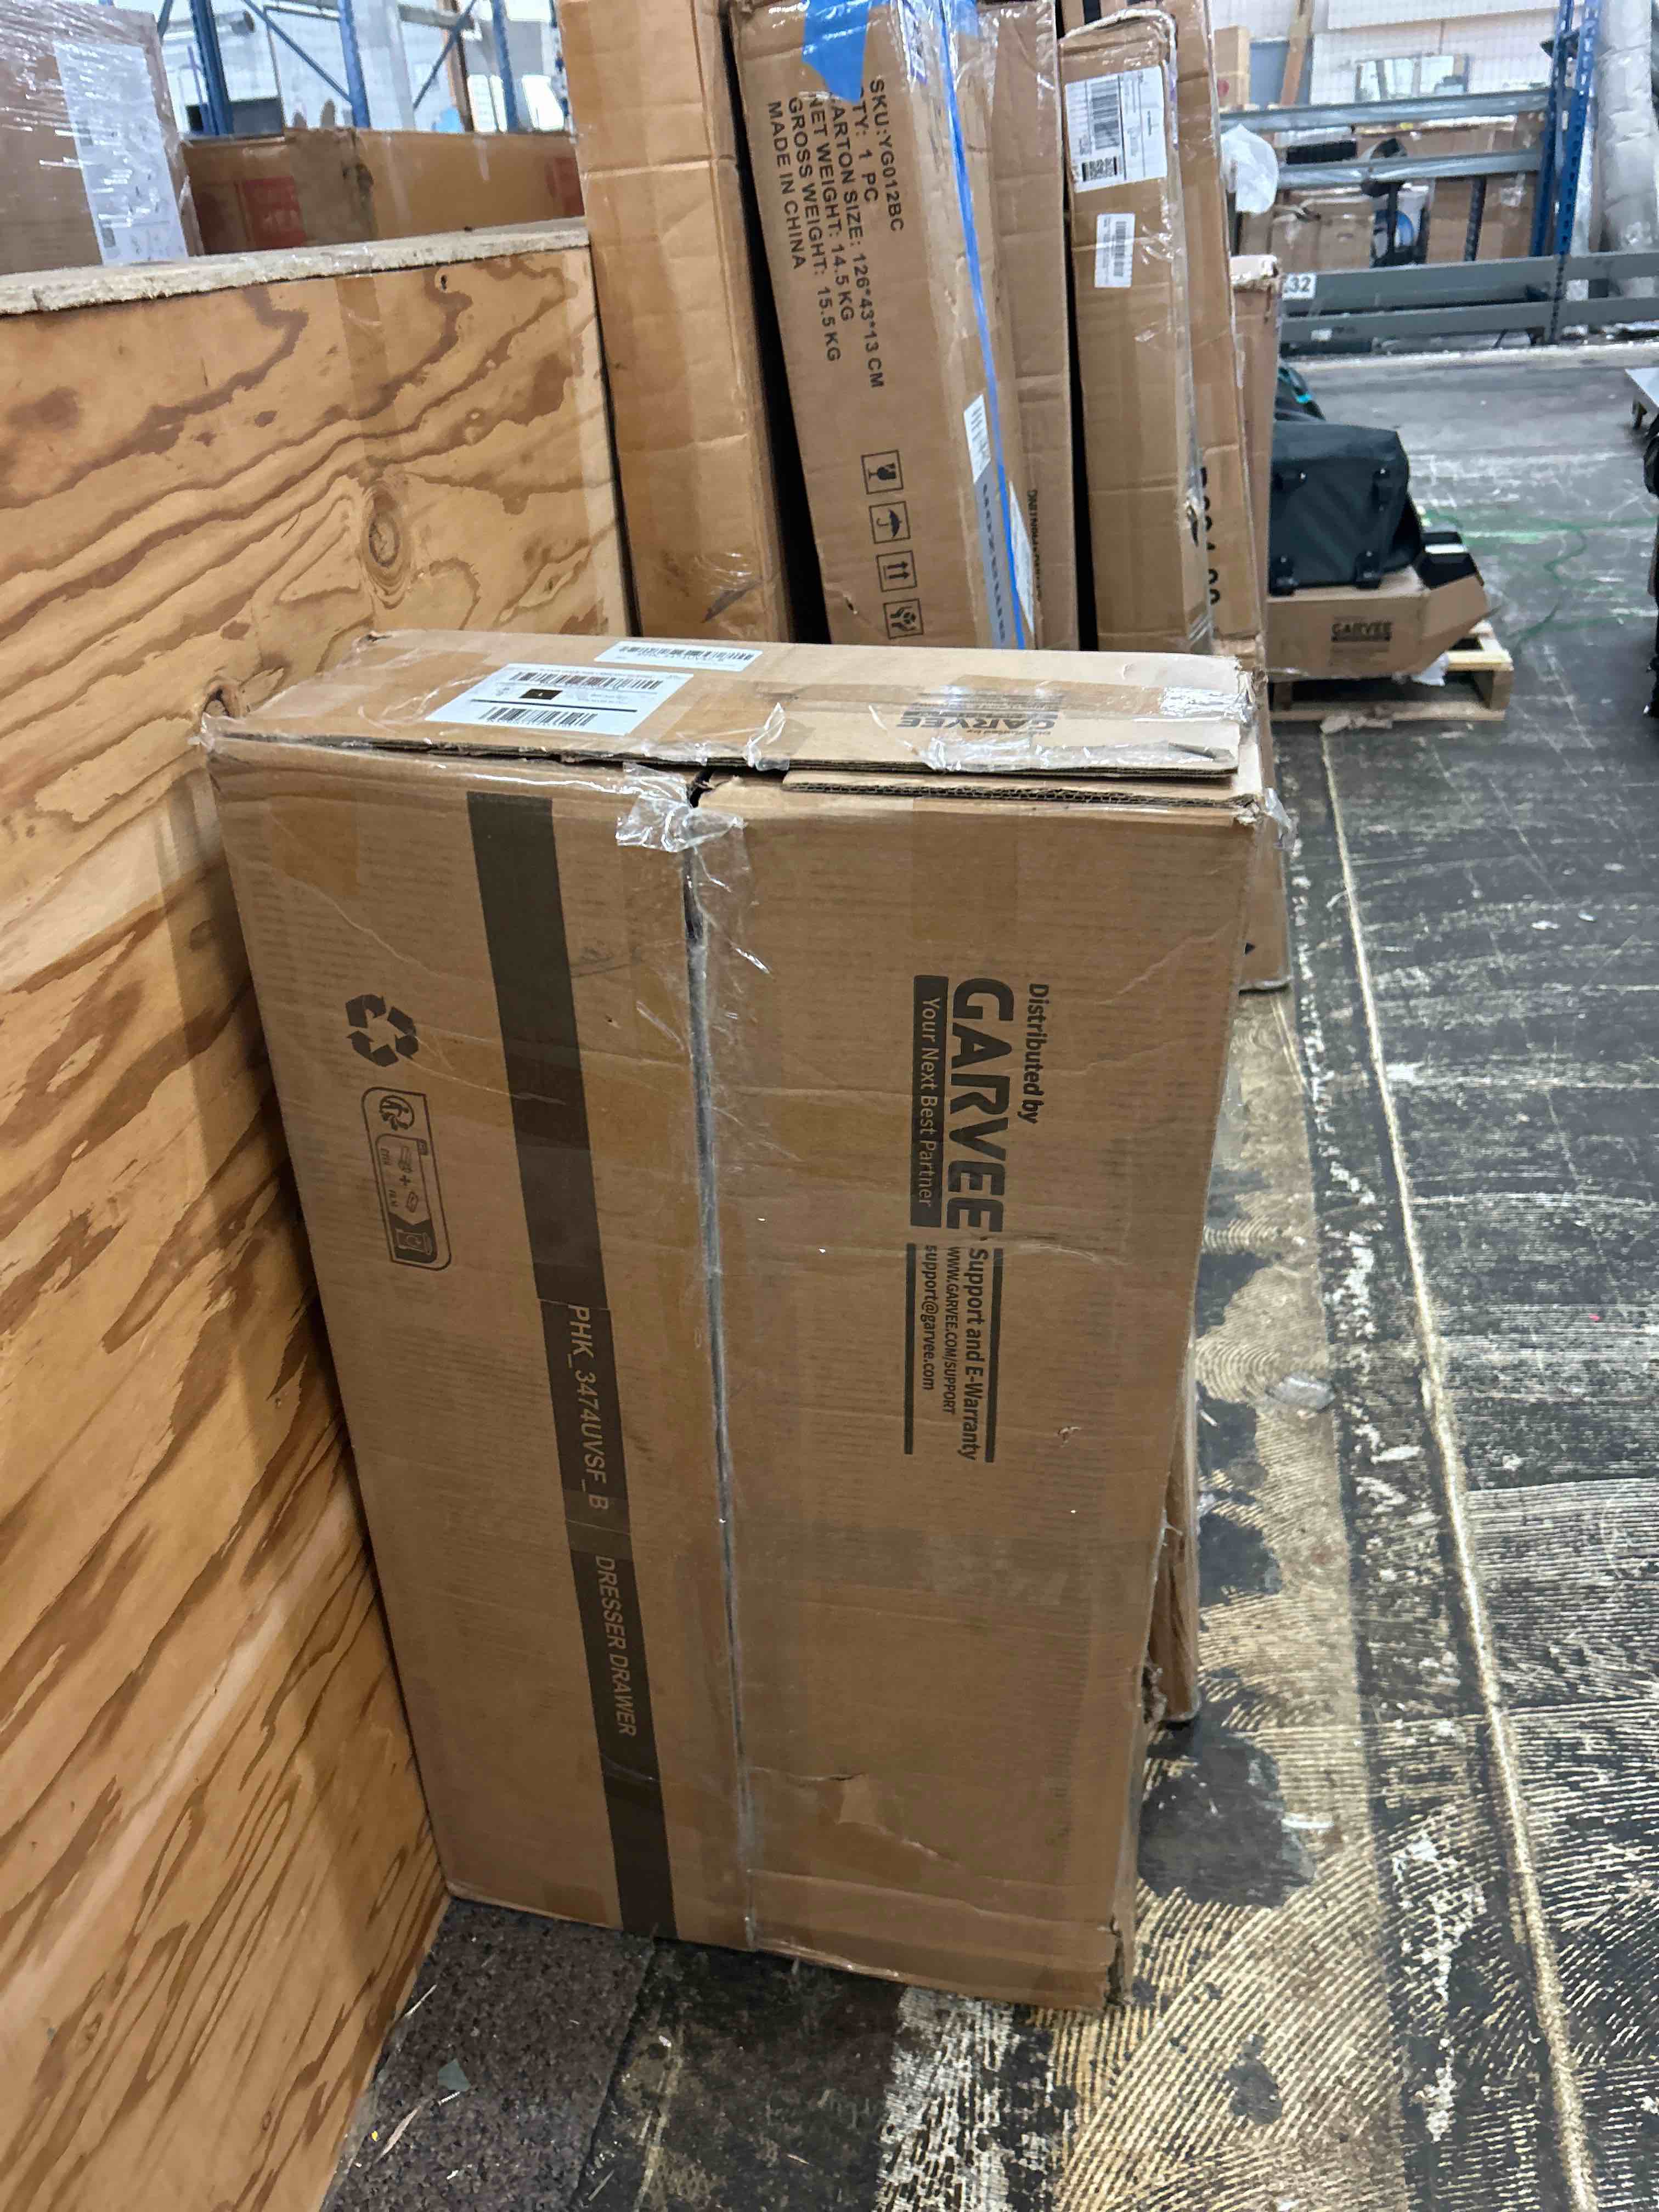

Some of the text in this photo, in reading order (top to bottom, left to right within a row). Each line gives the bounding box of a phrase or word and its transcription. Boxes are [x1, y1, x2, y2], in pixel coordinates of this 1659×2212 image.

[767, 101, 806, 269] MADE IN CHINA
[809, 98, 855, 321] NET WEIGHT: 14.5 KG
[831, 99, 856, 184] ARTON
[843, 190, 864, 247] SIZE:
[852, 86, 878, 202] TY: 1 PC
[870, 78, 904, 232] SKU:YG012BC
[789, 97, 841, 362] GROSS WEIGHT: 15.5 KG
[868, 358, 885, 388] CM
[896, 717, 1056, 729] GARVEE
[918, 997, 941, 1206] Your Next Best Partner
[946, 978, 1014, 1233] GARVEE
[1018, 983, 1050, 1124] Distributed by
[921, 1245, 939, 1391] support@garvee.com
[942, 1246, 960, 1415] WWW.GARVEE.COM/SUPPORT
[958, 1248, 989, 1461] Support and E-Warranty
[566, 1304, 609, 1510] PHK_3474UVSF_B
[596, 1555, 637, 1737] DRESSER DRAWER
